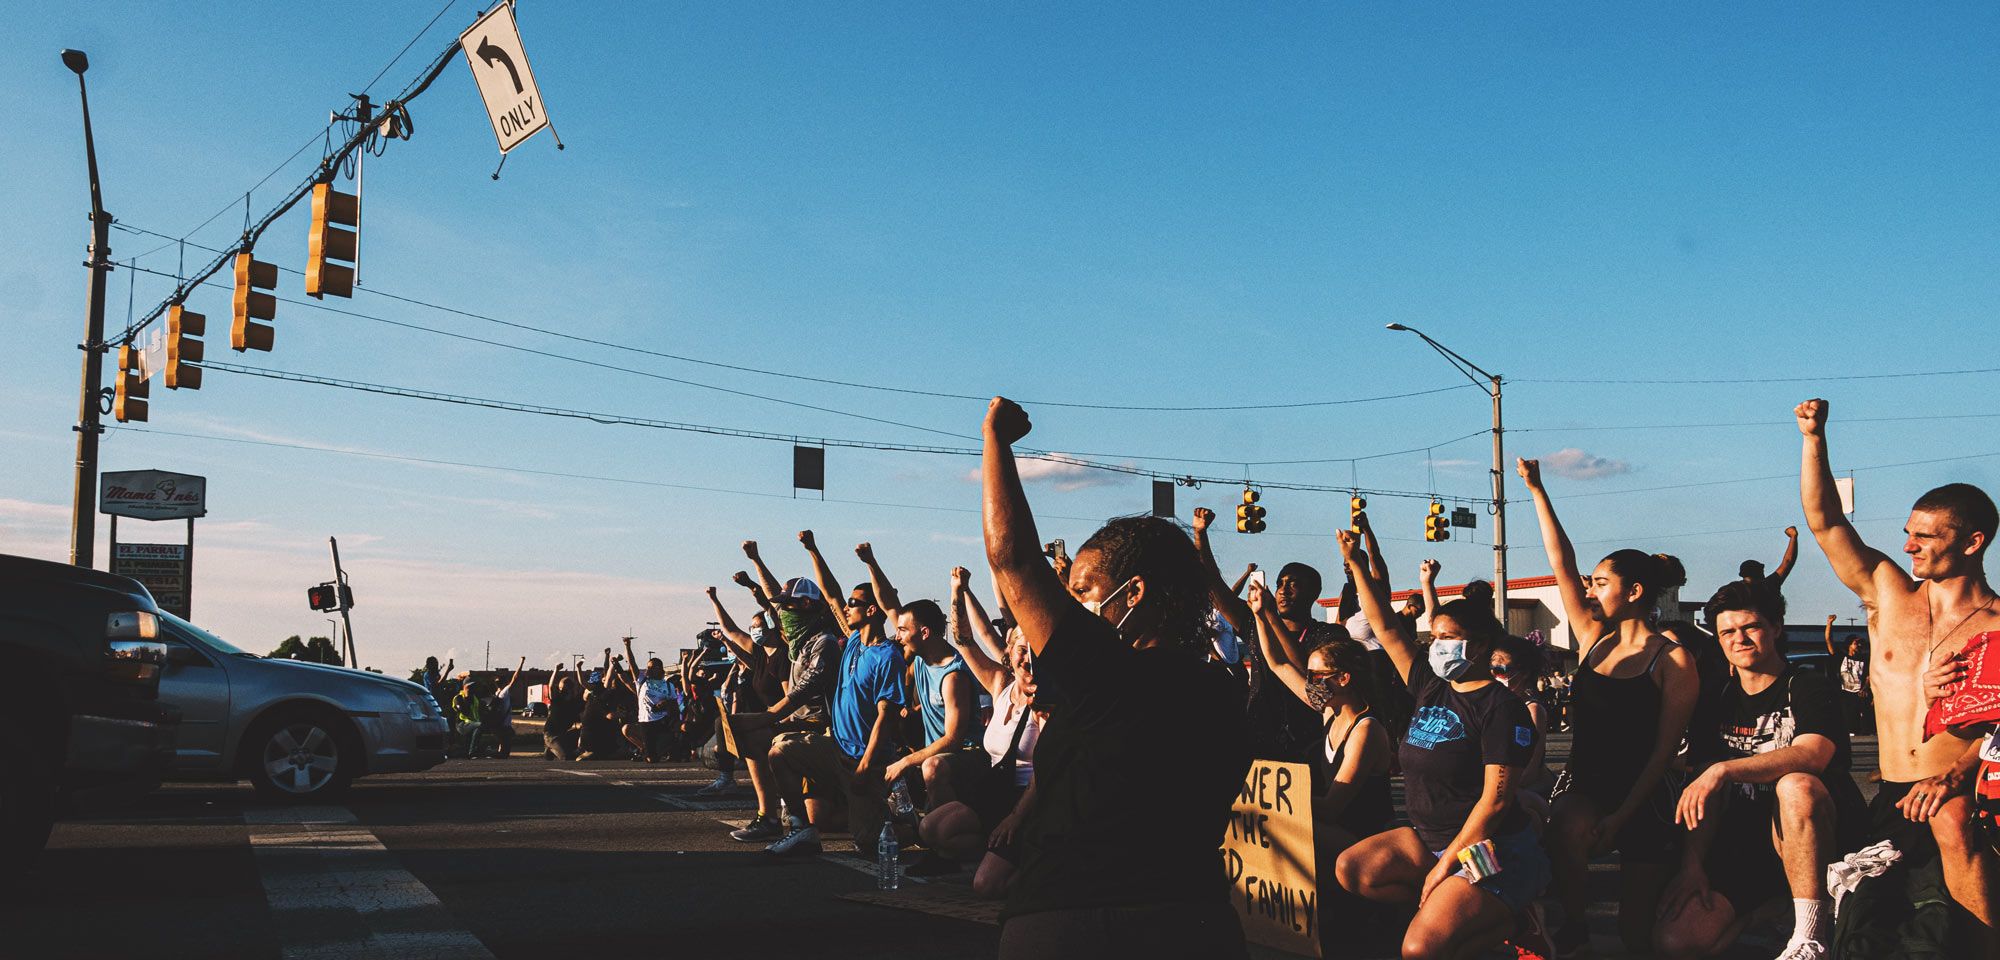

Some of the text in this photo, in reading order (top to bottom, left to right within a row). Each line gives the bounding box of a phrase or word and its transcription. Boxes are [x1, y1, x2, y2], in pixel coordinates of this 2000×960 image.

[500, 96, 536, 137] ONLY
[119, 545, 182, 555] EL PARRAL
[1231, 810, 1270, 849] THE
[1245, 876, 1315, 937] FAMILY
